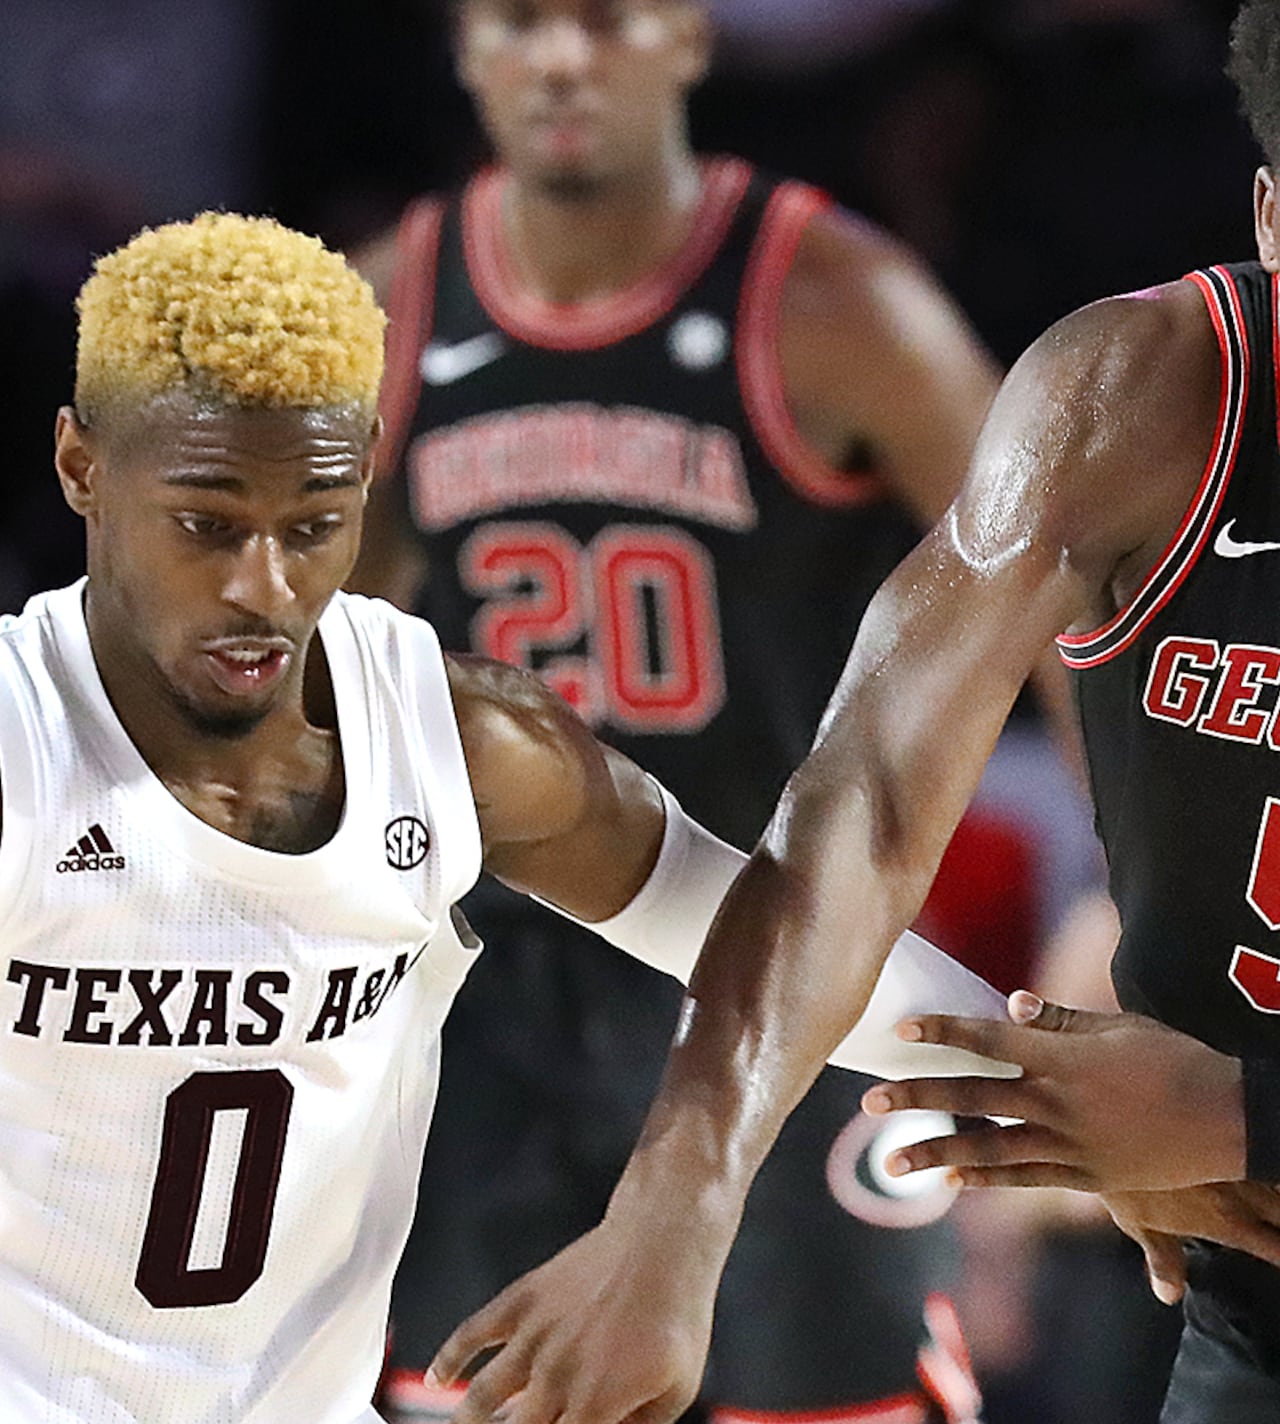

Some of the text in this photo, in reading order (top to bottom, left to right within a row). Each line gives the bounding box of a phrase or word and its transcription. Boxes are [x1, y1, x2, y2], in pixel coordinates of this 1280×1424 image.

[460, 522, 726, 732] 20
[56, 853, 126, 873] adidas
[386, 818, 428, 868] SEC
[6, 958, 290, 1046] TEXAS
[135, 1068, 295, 1309] 0
